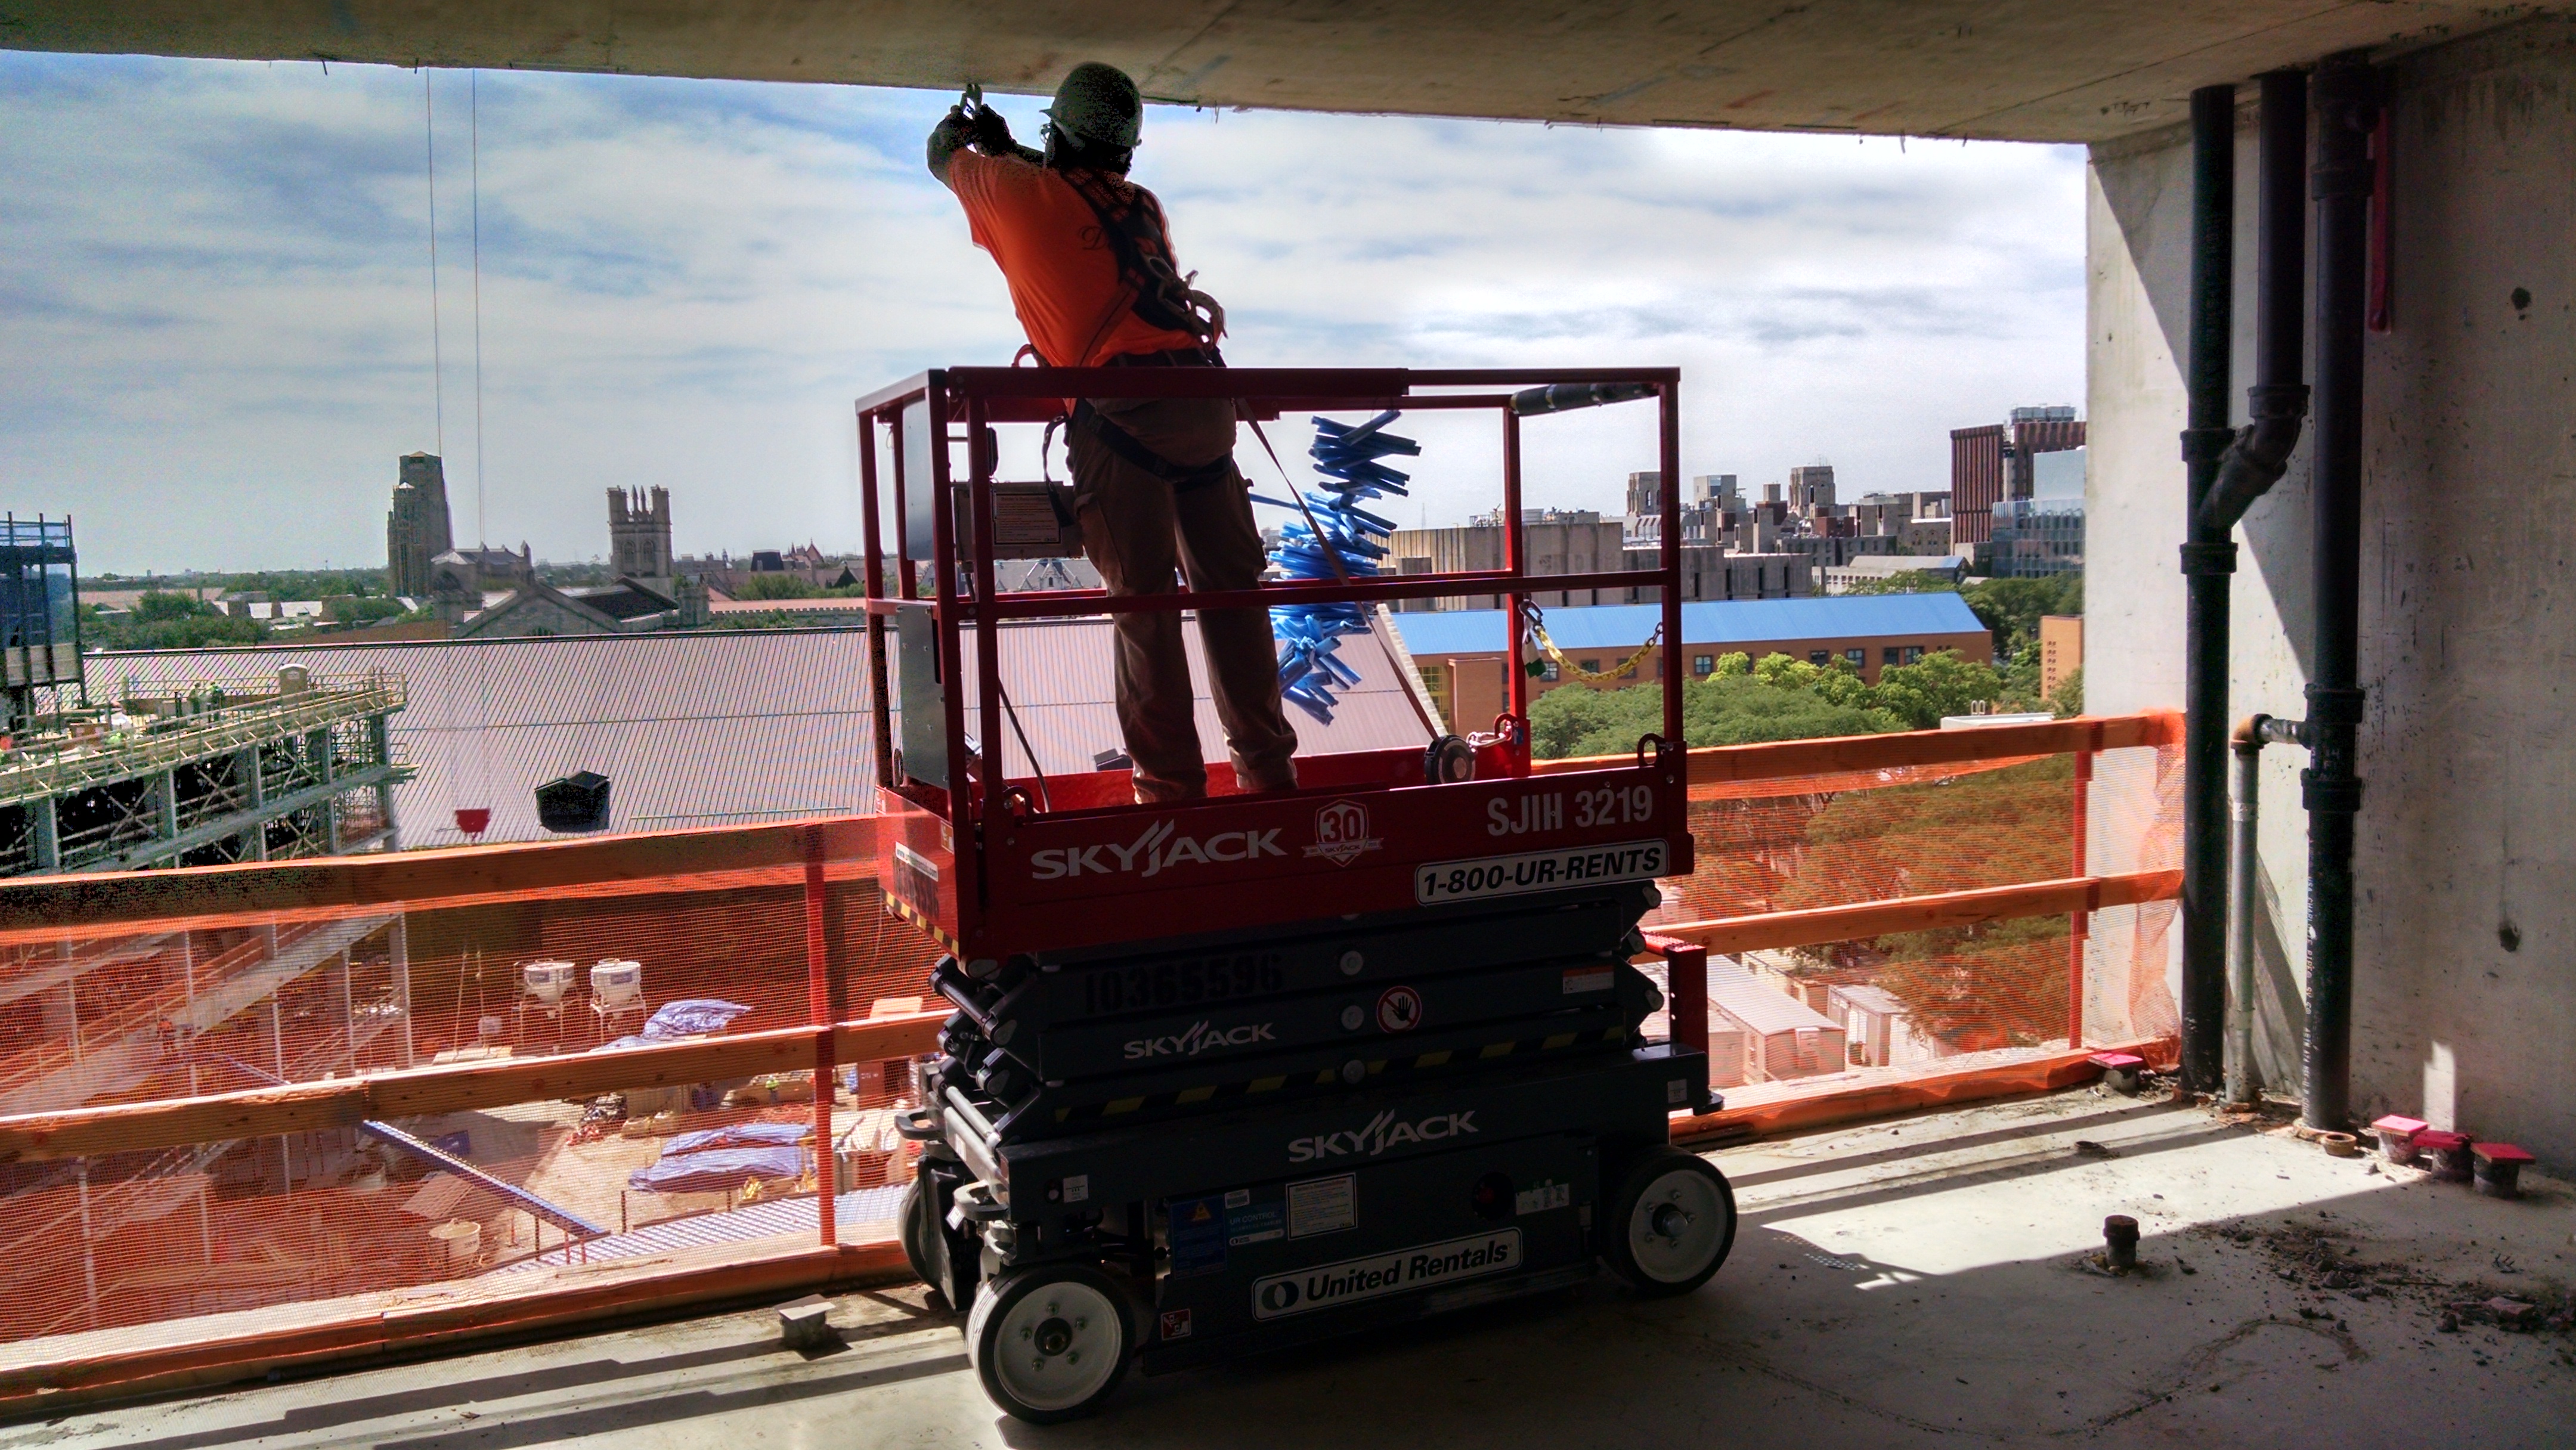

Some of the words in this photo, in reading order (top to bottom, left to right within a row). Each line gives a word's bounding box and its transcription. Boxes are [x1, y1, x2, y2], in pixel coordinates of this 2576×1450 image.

[1323, 808, 1361, 842] 30
[1575, 785, 1653, 828] 3219
[1032, 819, 1288, 880] SKYJACK
[1324, 844, 1361, 853] SKYJACK
[1423, 847, 1661, 897] 1-800-UR-RENTS
[1085, 953, 1283, 1015] 10365596
[1124, 1020, 1278, 1059] SKYJACK
[1288, 1108, 1479, 1164] SKYJACK
[1242, 1211, 1277, 1223] CONTROL
[1306, 1261, 1401, 1302] United
